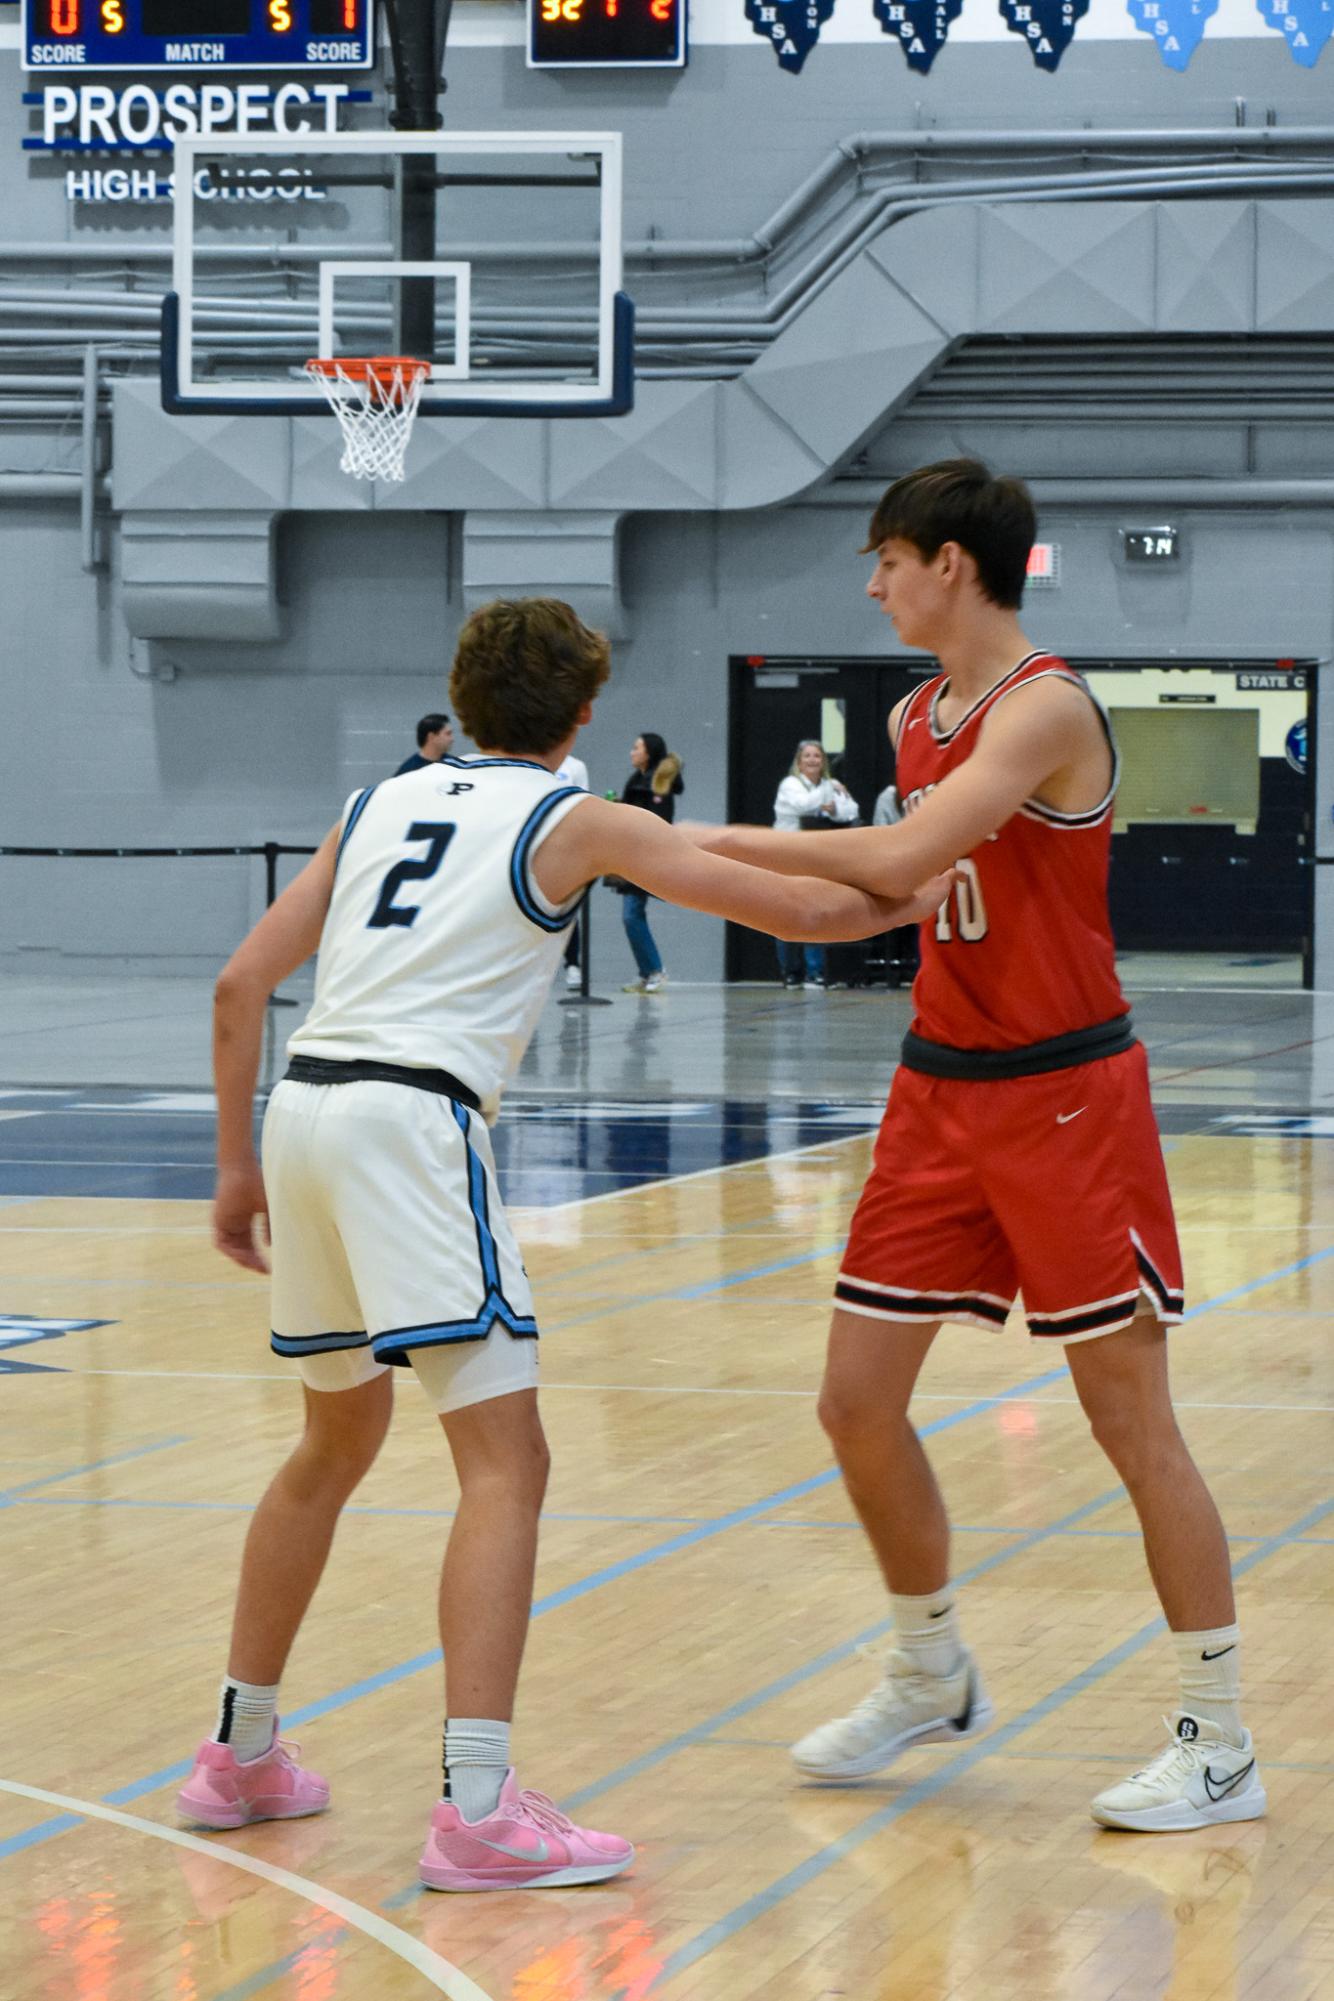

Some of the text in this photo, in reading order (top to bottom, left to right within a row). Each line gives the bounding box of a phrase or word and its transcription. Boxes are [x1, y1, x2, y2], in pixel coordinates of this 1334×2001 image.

[32, 42, 362, 64] SCORE MATCH SCORE
[43, 83, 349, 145] PROSPECT
[66, 170, 156, 200] HIGH
[1239, 675, 1289, 688] STATE
[447, 782, 474, 795] P
[366, 820, 458, 930] 2
